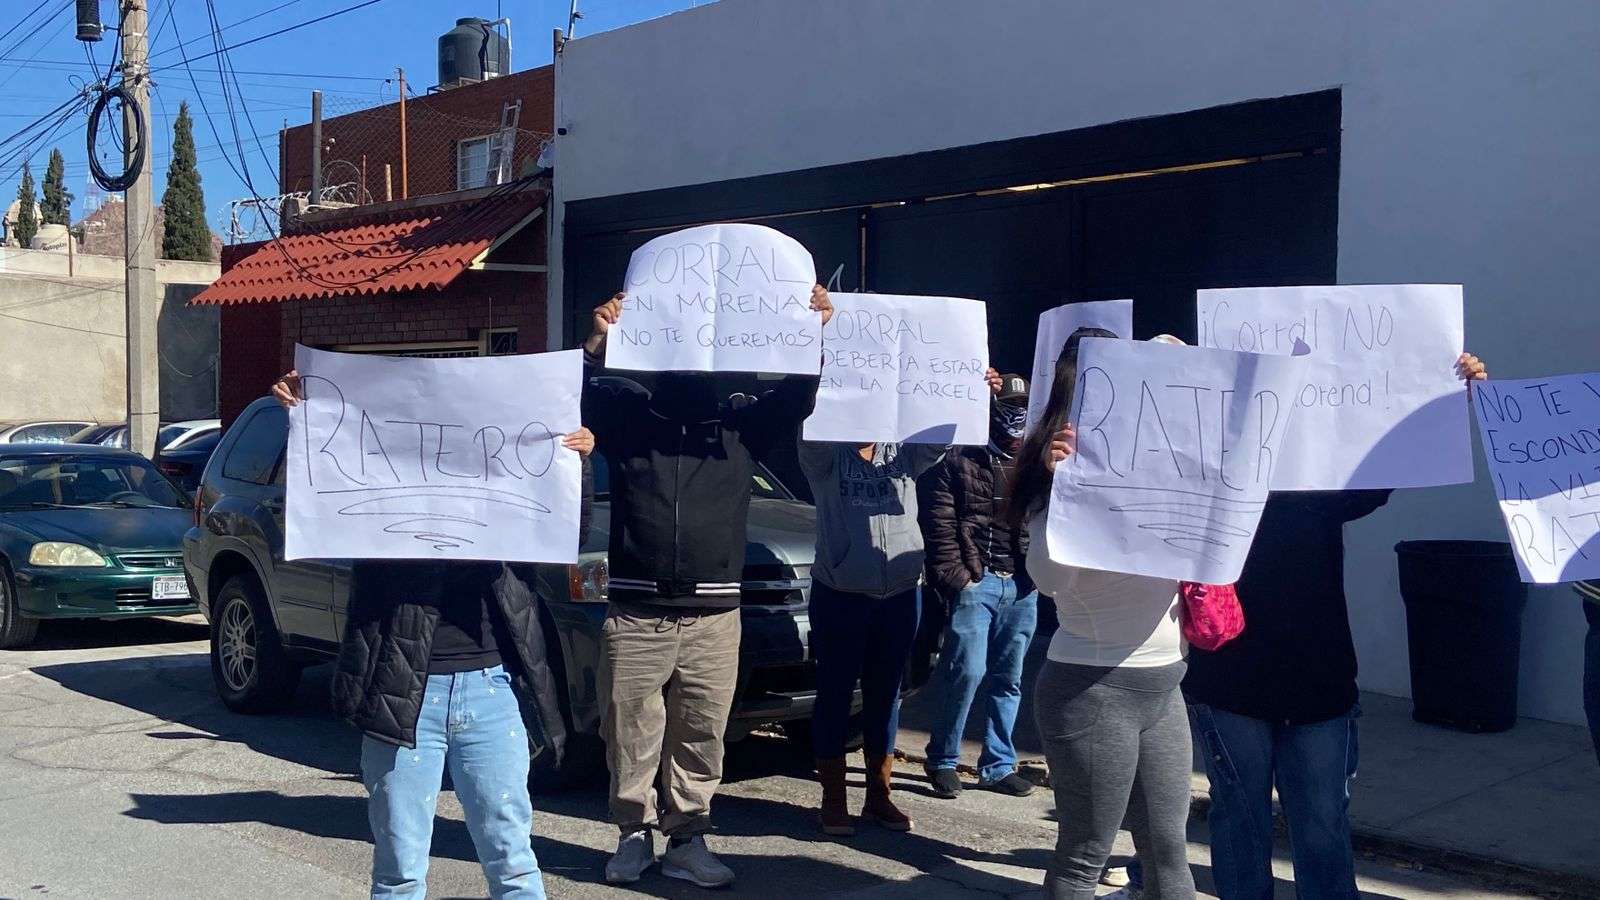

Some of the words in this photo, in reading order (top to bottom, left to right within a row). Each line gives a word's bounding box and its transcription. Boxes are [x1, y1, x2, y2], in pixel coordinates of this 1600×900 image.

[629, 241, 809, 287] CORRAL
[676, 291, 806, 314] MORENA
[620, 328, 652, 346] NO
[660, 327, 683, 343] TE
[1343, 303, 1394, 351] NO
[929, 358, 984, 376] ESTAR
[860, 378, 883, 392] LA
[1477, 384, 1522, 423] NO
[1524, 383, 1571, 416] TE
[300, 374, 557, 487] RATERO
[1498, 472, 1533, 506] LA
